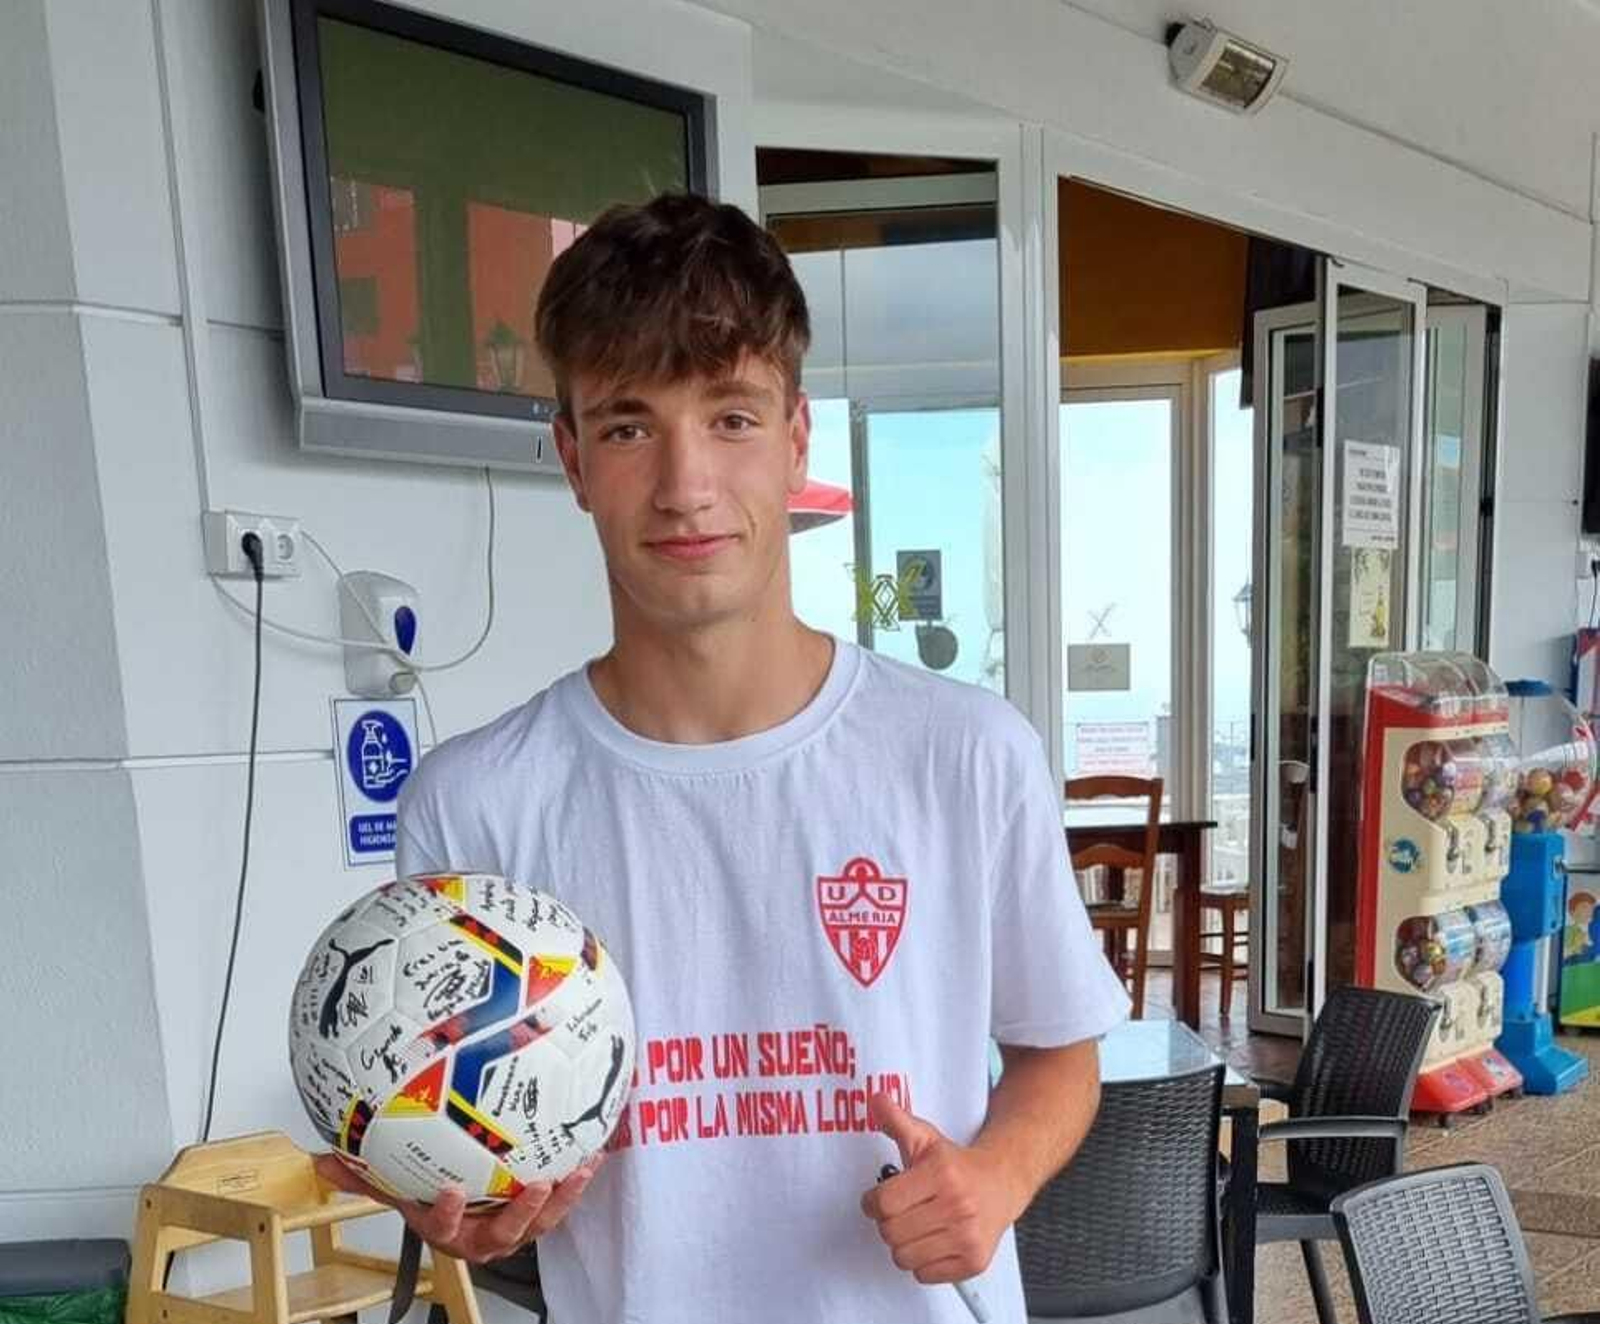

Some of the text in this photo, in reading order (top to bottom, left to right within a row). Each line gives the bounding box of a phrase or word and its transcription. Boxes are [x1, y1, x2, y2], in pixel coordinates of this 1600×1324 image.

[828, 886, 896, 901] U D
[829, 911, 896, 923] ALMERIA
[647, 1037, 703, 1085] POR
[712, 1033, 749, 1079] UN
[757, 1024, 856, 1079] SUEÑO;
[639, 1097, 689, 1146] POR
[696, 1090, 729, 1138] LA
[735, 1090, 808, 1137] MISMA
